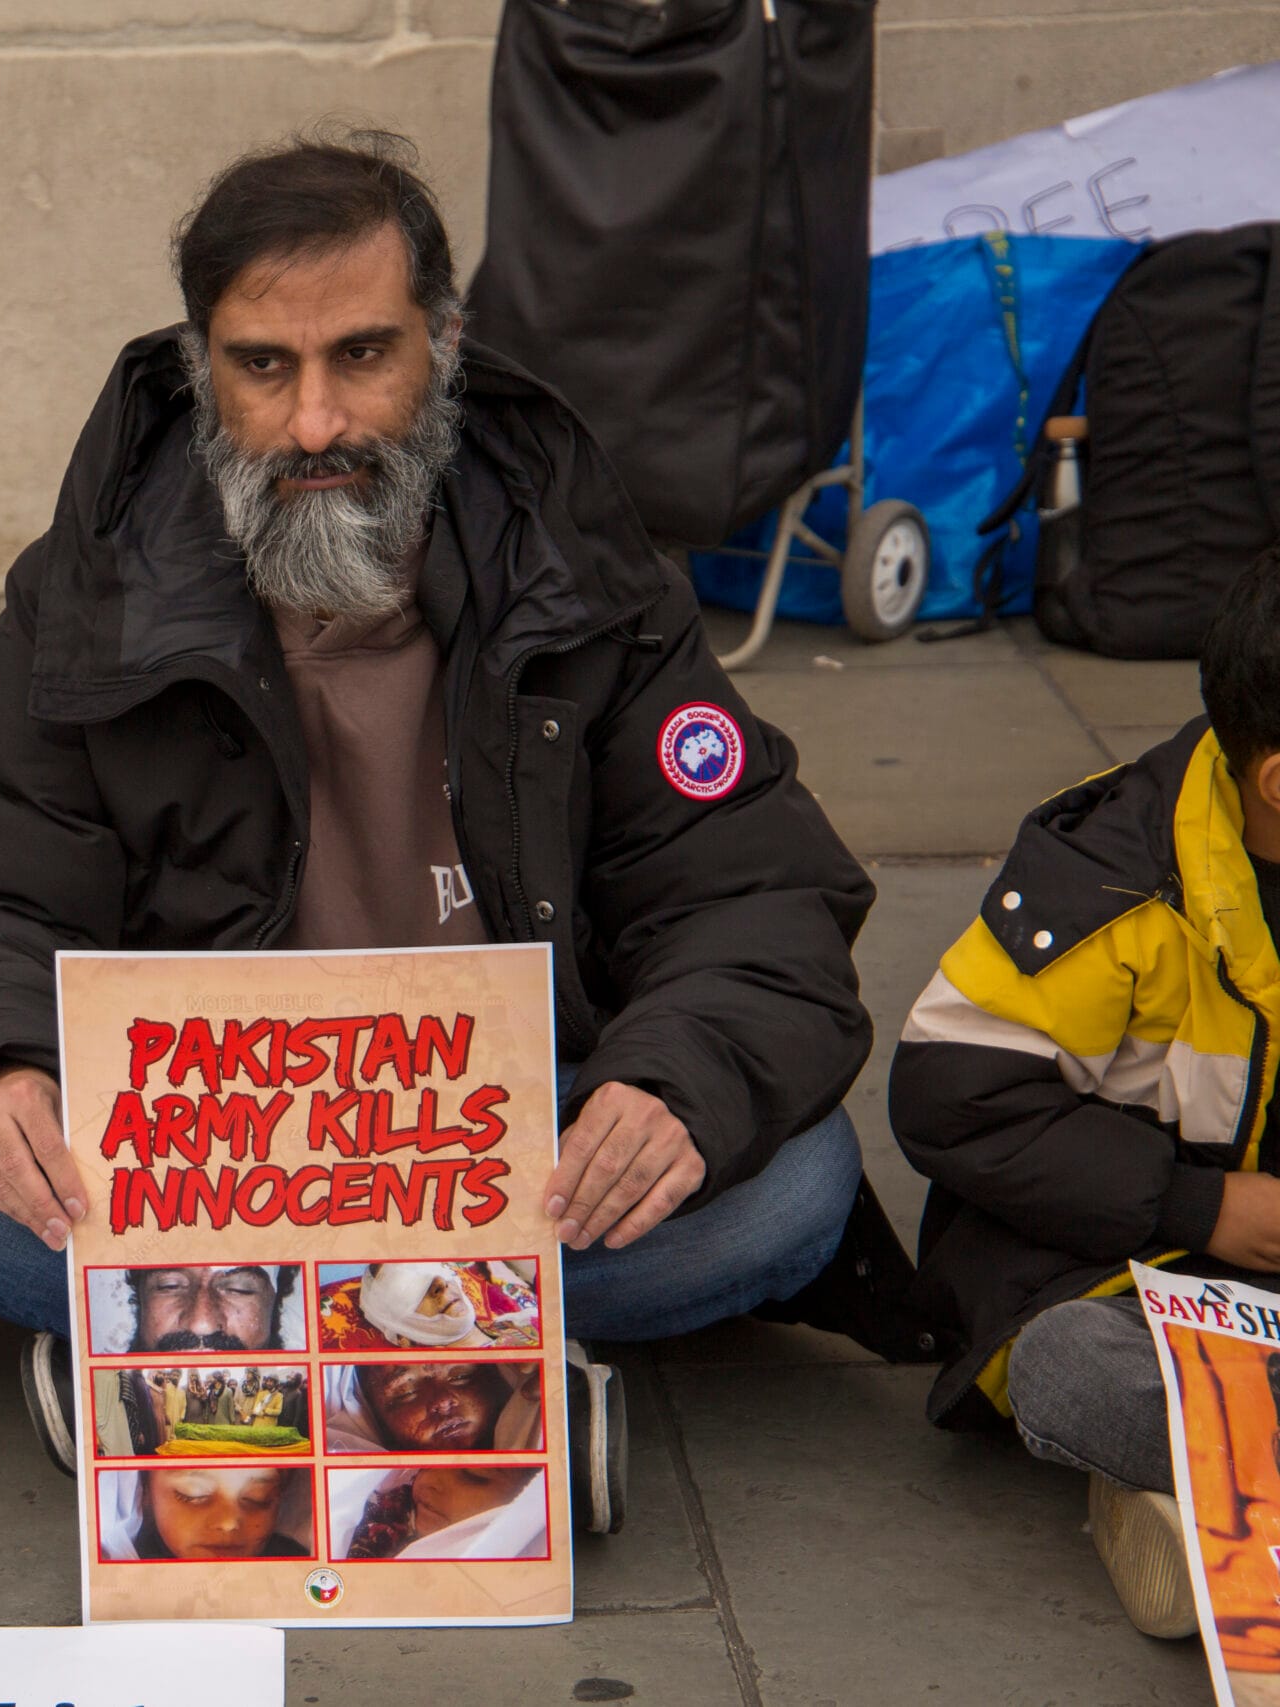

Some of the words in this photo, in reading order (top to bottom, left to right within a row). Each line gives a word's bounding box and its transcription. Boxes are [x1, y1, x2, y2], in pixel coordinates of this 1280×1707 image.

[665, 717, 685, 749] CANADA
[687, 711, 721, 722] GOOSE
[126, 1011, 476, 1094] PAKISTAN
[100, 1089, 295, 1168] ARMY
[306, 1083, 512, 1159] KILLS
[109, 1156, 512, 1236] INNOCENTS
[1144, 1288, 1234, 1330] SAVE
